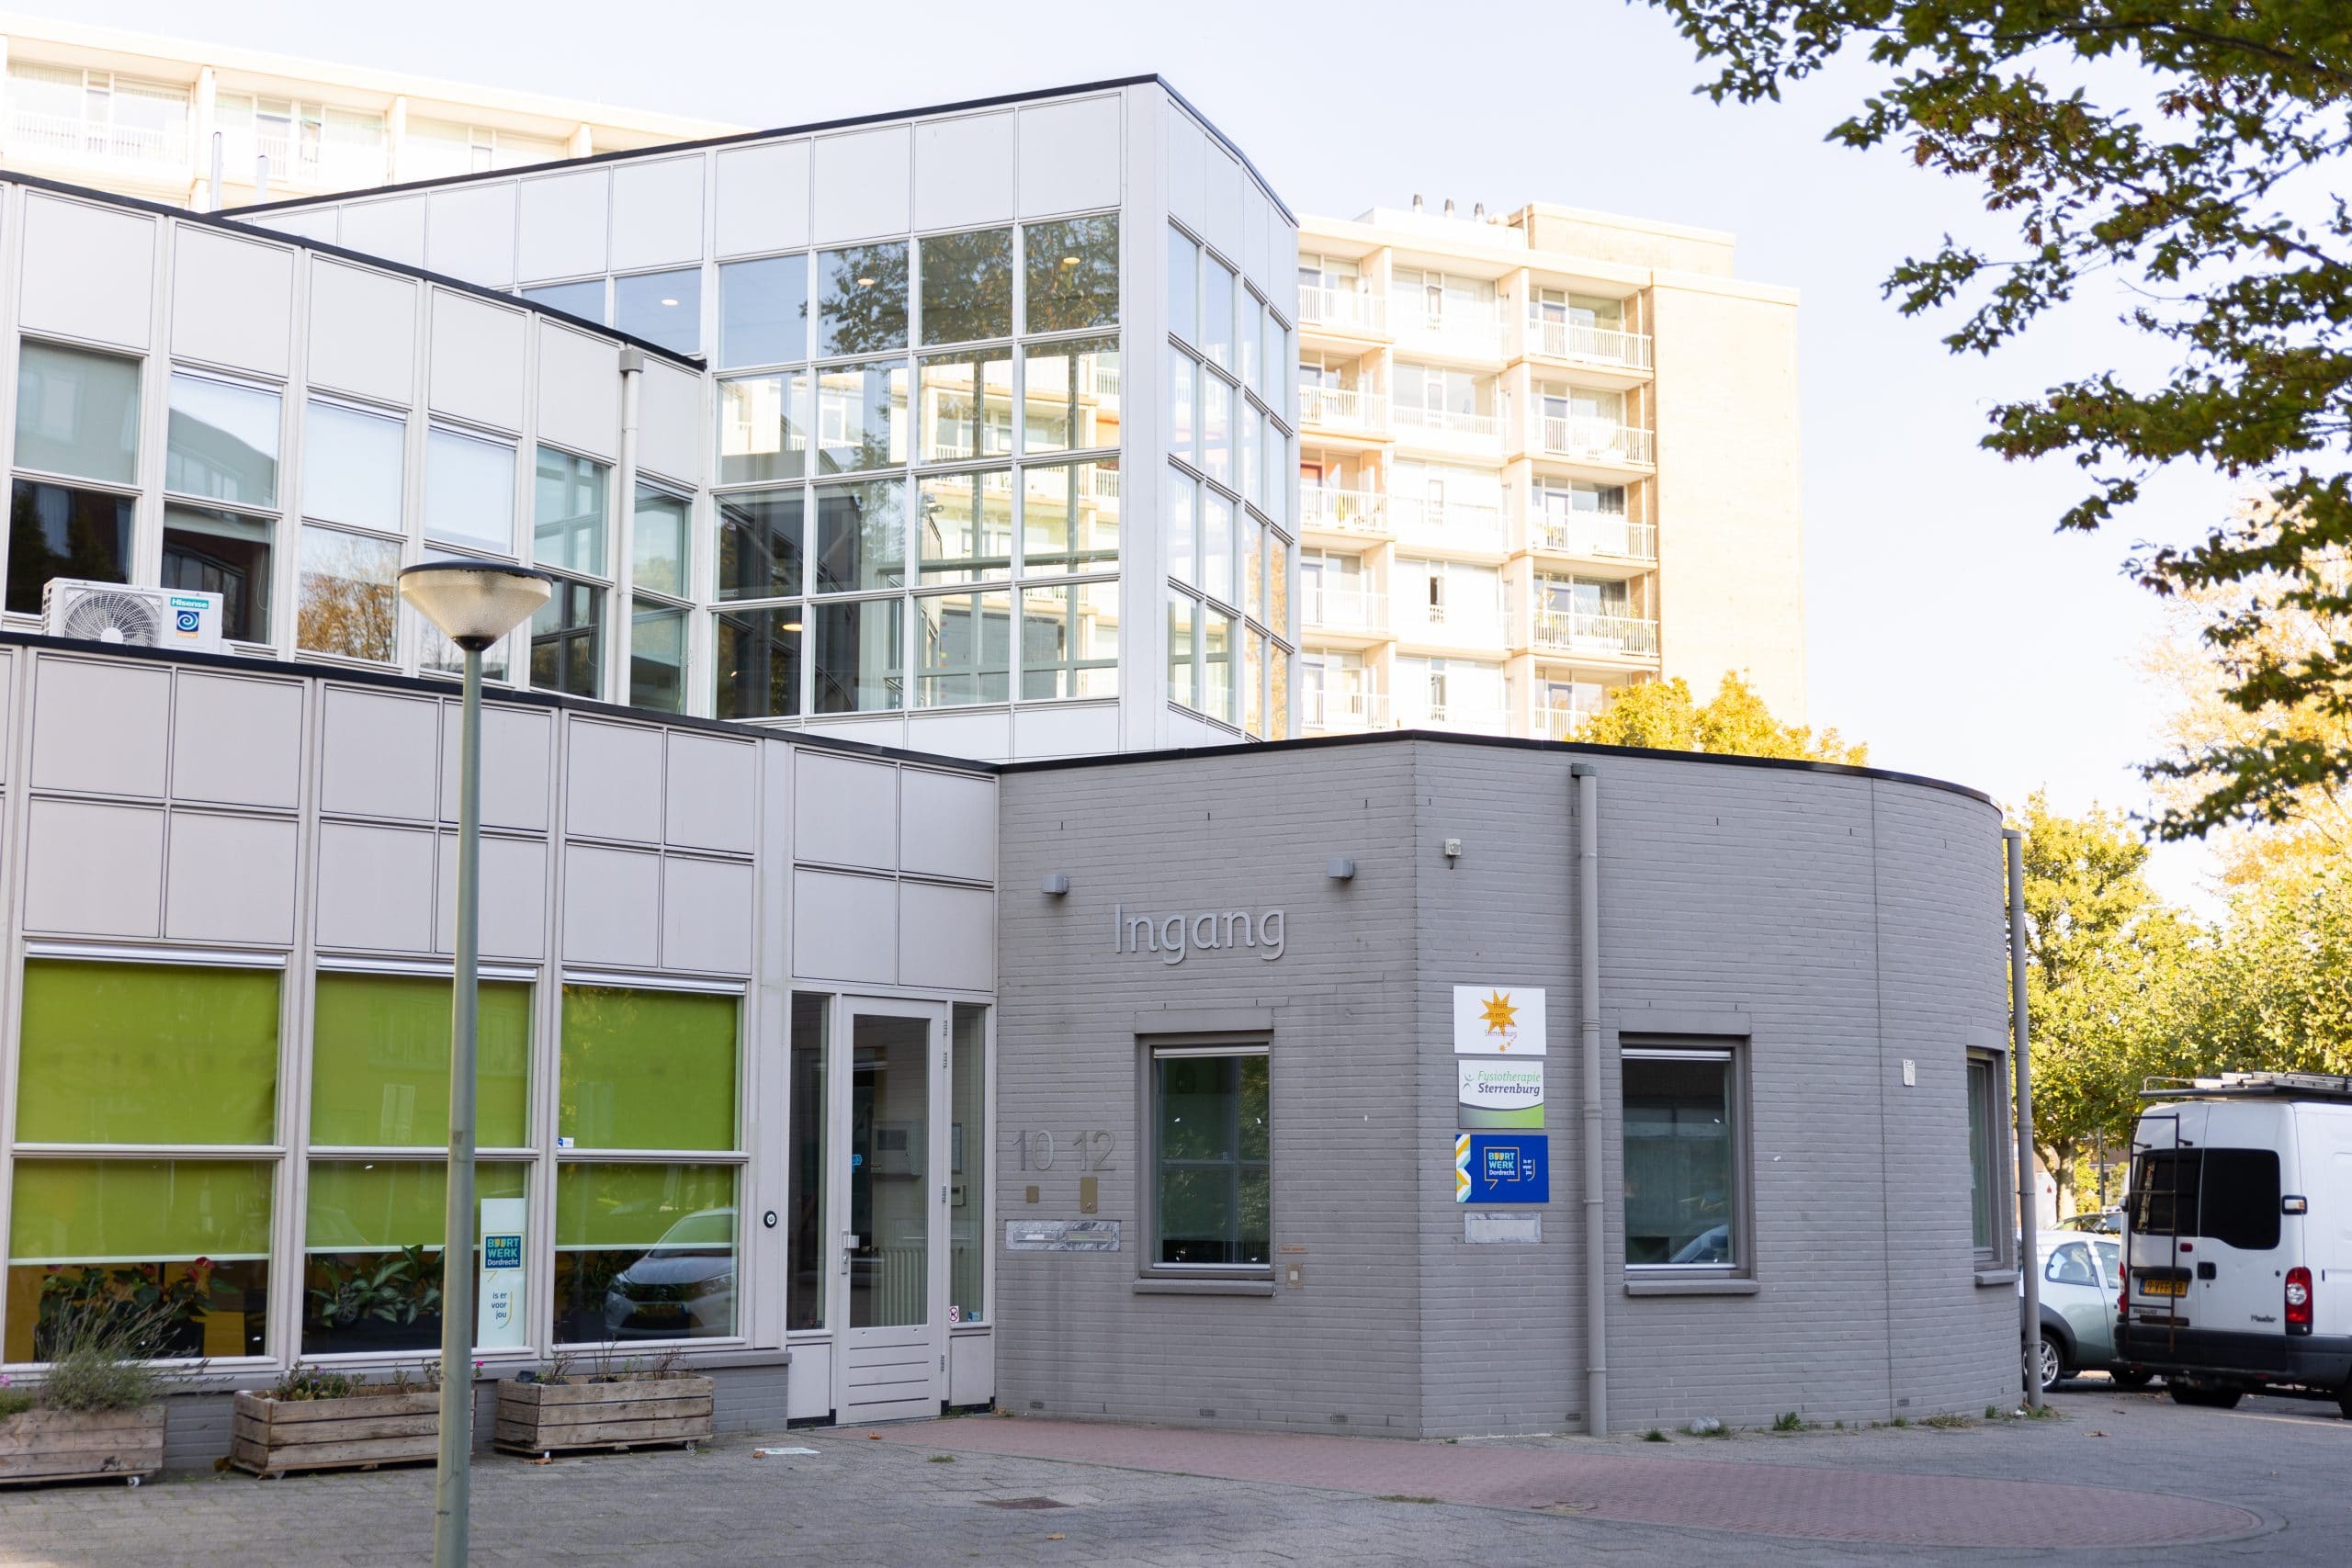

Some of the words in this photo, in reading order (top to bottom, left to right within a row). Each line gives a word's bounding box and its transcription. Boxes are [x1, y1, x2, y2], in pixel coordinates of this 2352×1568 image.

[172, 598, 209, 608] Hisense
[1114, 904, 1285, 964] Ingang
[1493, 1001, 1508, 1010] thuis
[1484, 1029, 1518, 1039] Sterrenburg
[1477, 1070, 1541, 1084] Fysiotherapie
[1478, 1083, 1541, 1097] Sterrenburg
[1012, 1130, 1054, 1171] 10
[1073, 1130, 1116, 1171] 12
[1488, 1160, 1514, 1169] WERK
[487, 1248, 517, 1258] WERK
[495, 1310, 506, 1320] jou
